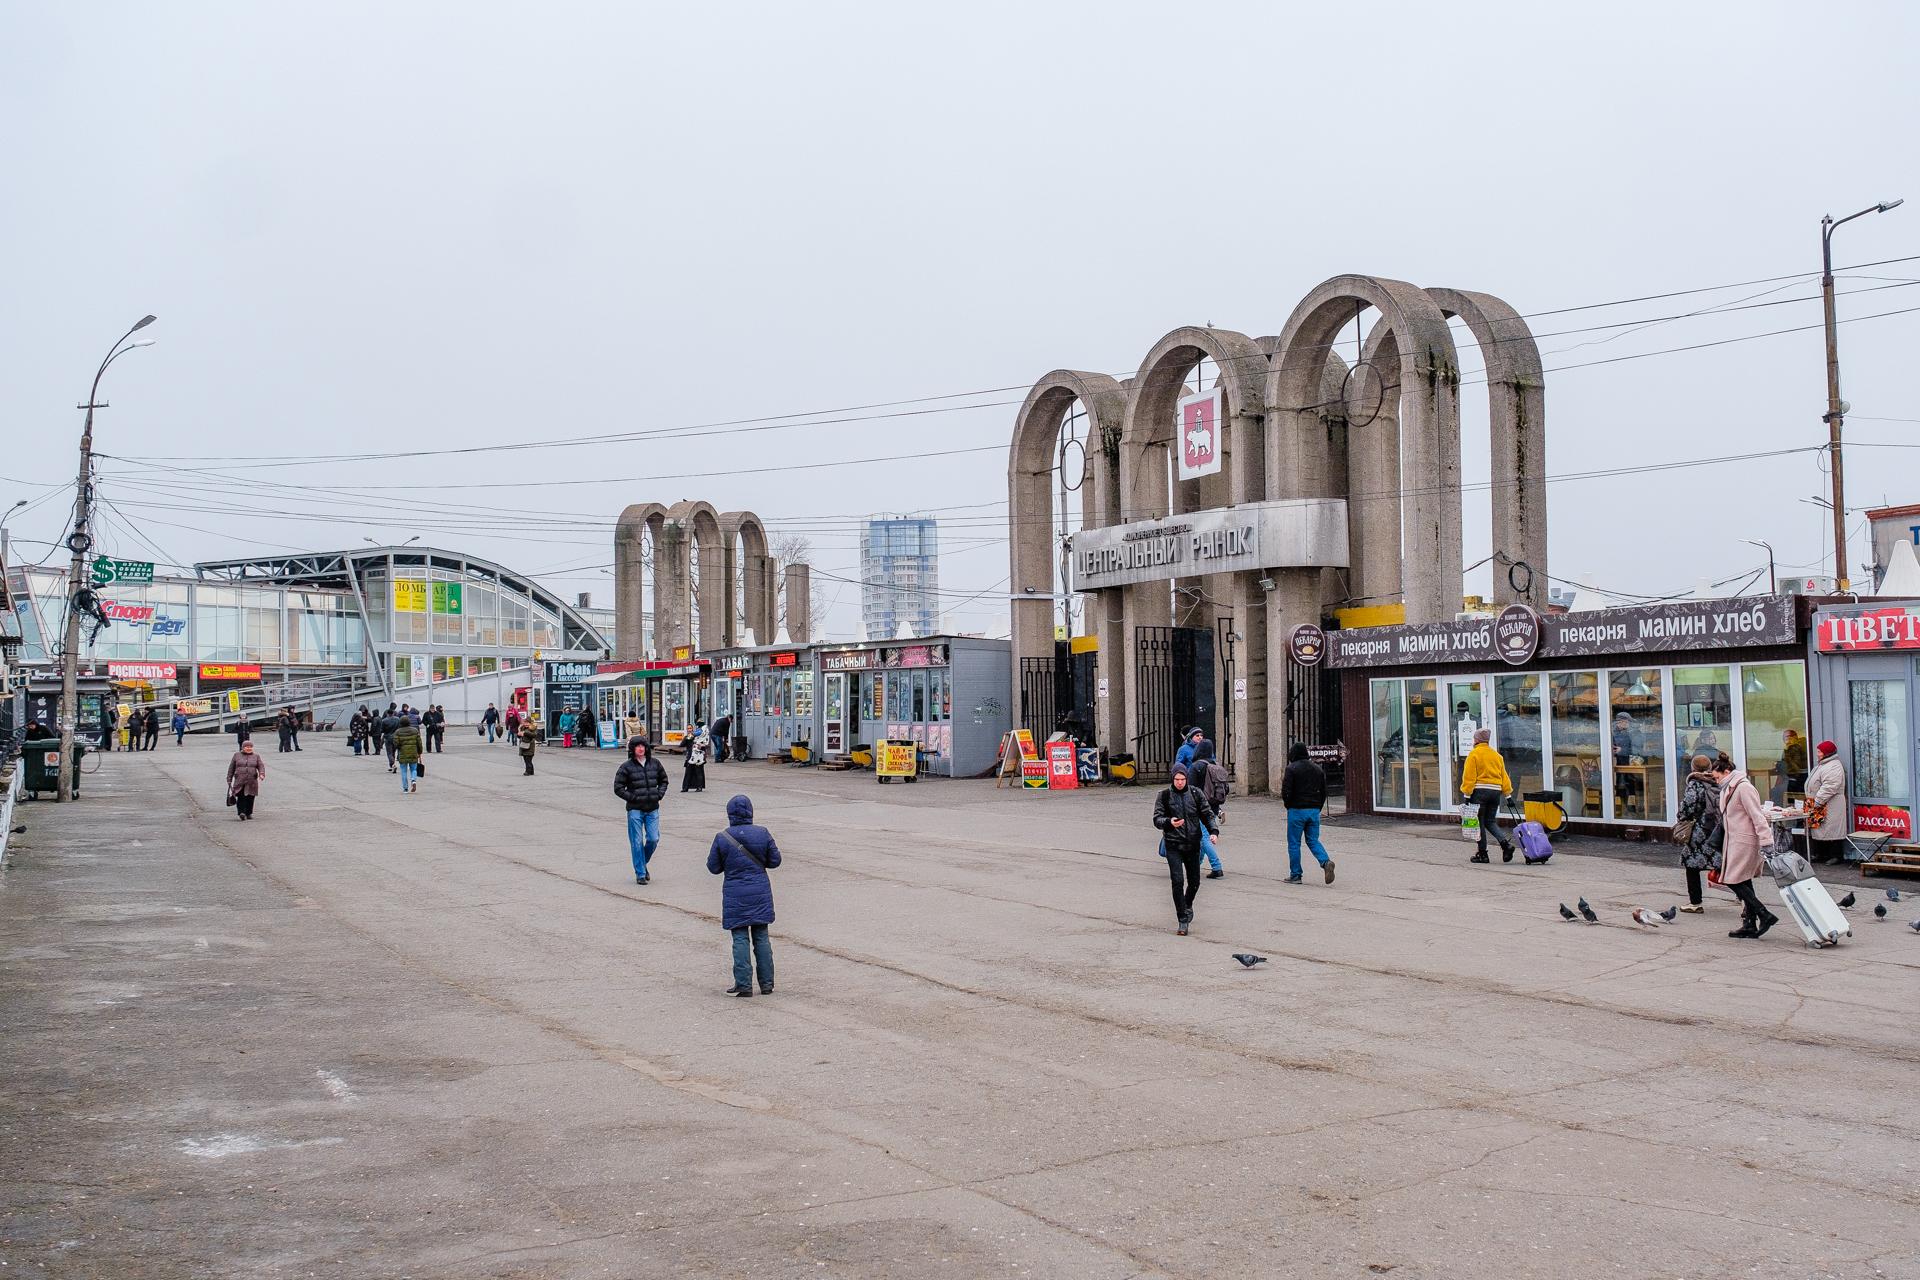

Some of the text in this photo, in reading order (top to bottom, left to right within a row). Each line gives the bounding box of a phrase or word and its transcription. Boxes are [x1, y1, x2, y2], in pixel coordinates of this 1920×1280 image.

[1078, 526, 1253, 577] ЦЕНТРАЛЬНЫЙ РЫНОК
[394, 582, 456, 596] ЛОМБАРД
[1499, 621, 1533, 638] ПЕКАРНЯ
[1560, 623, 1627, 645] пекарня
[1638, 614, 1706, 638] мамин
[1712, 604, 1766, 633] хлеб
[1295, 635, 1322, 647] ПЕКАРНЯ
[1341, 625, 1491, 658] пекарня мамин хлеб
[721, 656, 749, 669] ТАБАК
[825, 654, 867, 669] ТАБАЧНЫЙ
[109, 665, 163, 678] РОСПЕЧАТЬ
[550, 663, 591, 676] Табак
[1858, 816, 1906, 828] РАССАДА
